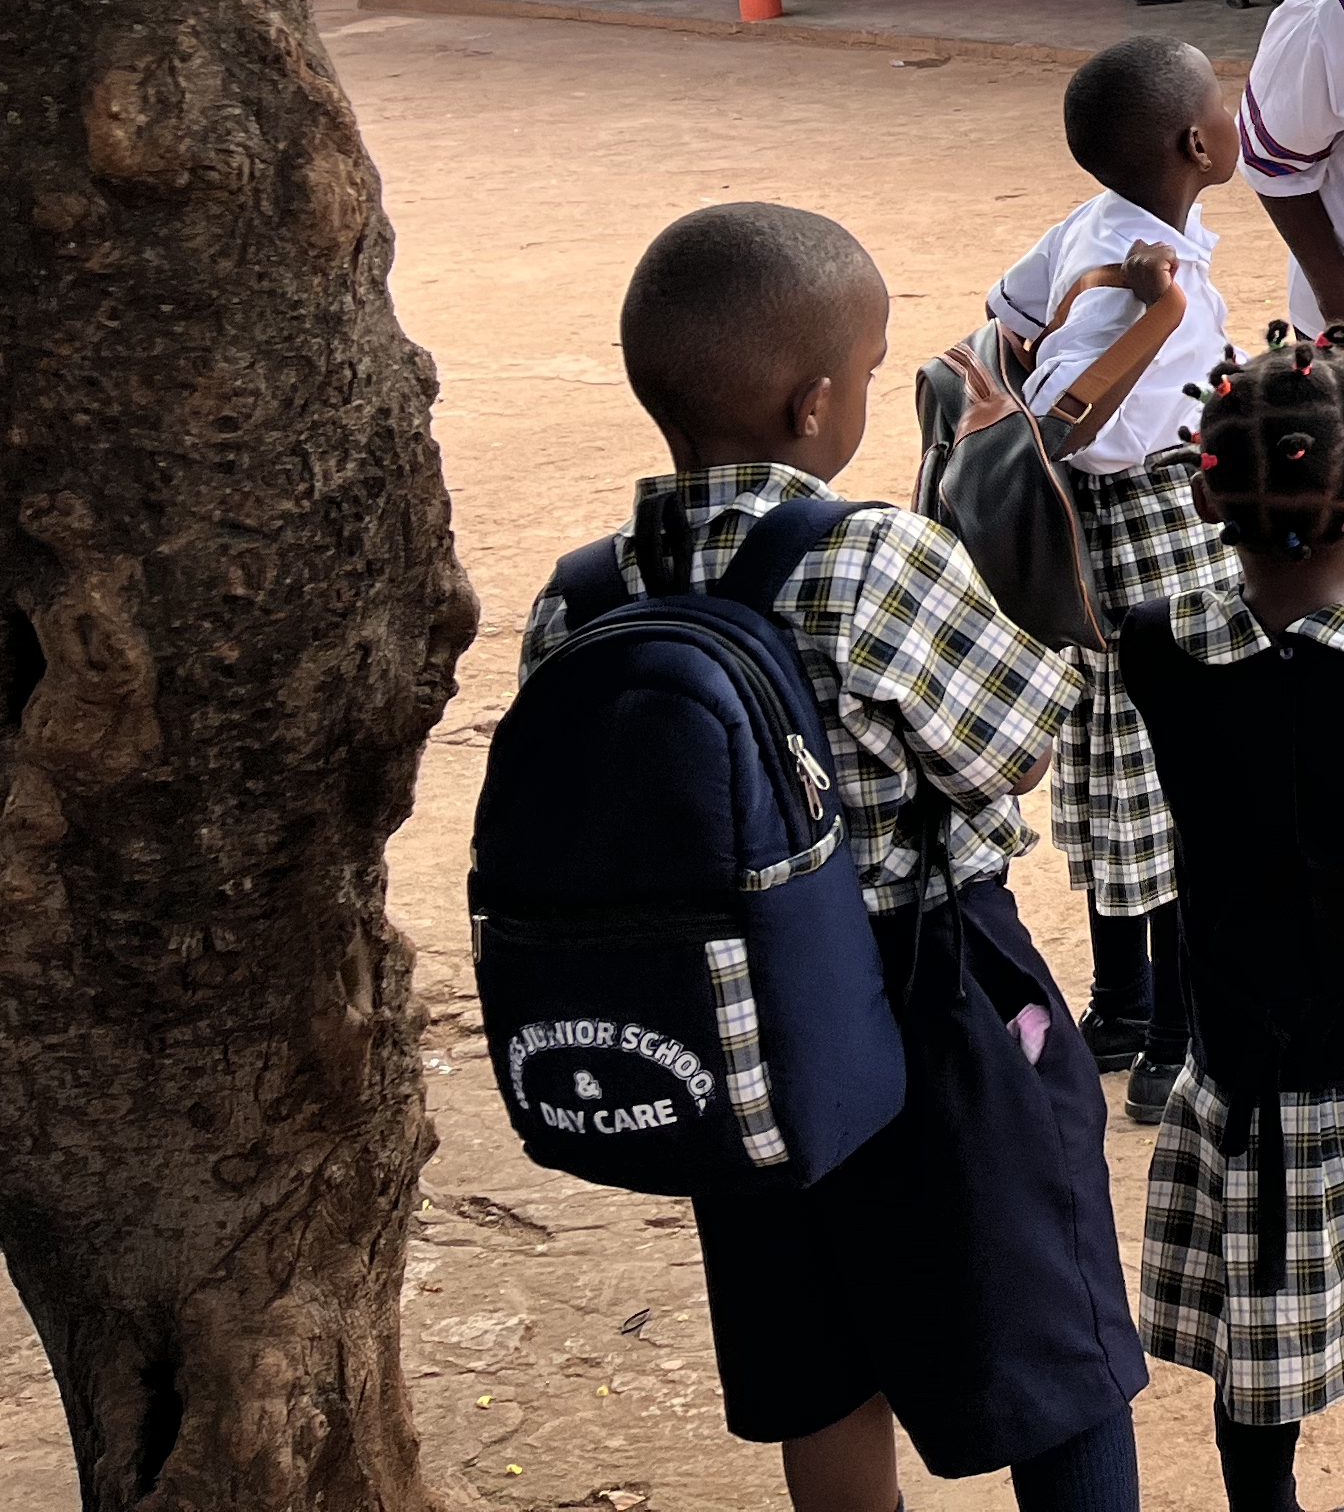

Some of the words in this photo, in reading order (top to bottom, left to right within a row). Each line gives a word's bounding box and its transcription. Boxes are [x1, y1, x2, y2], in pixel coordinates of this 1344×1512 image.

[520, 1017, 617, 1055] JUNIOR
[573, 1070, 602, 1099] &
[540, 1101, 586, 1134] DAY
[593, 1098, 678, 1134] CARE
